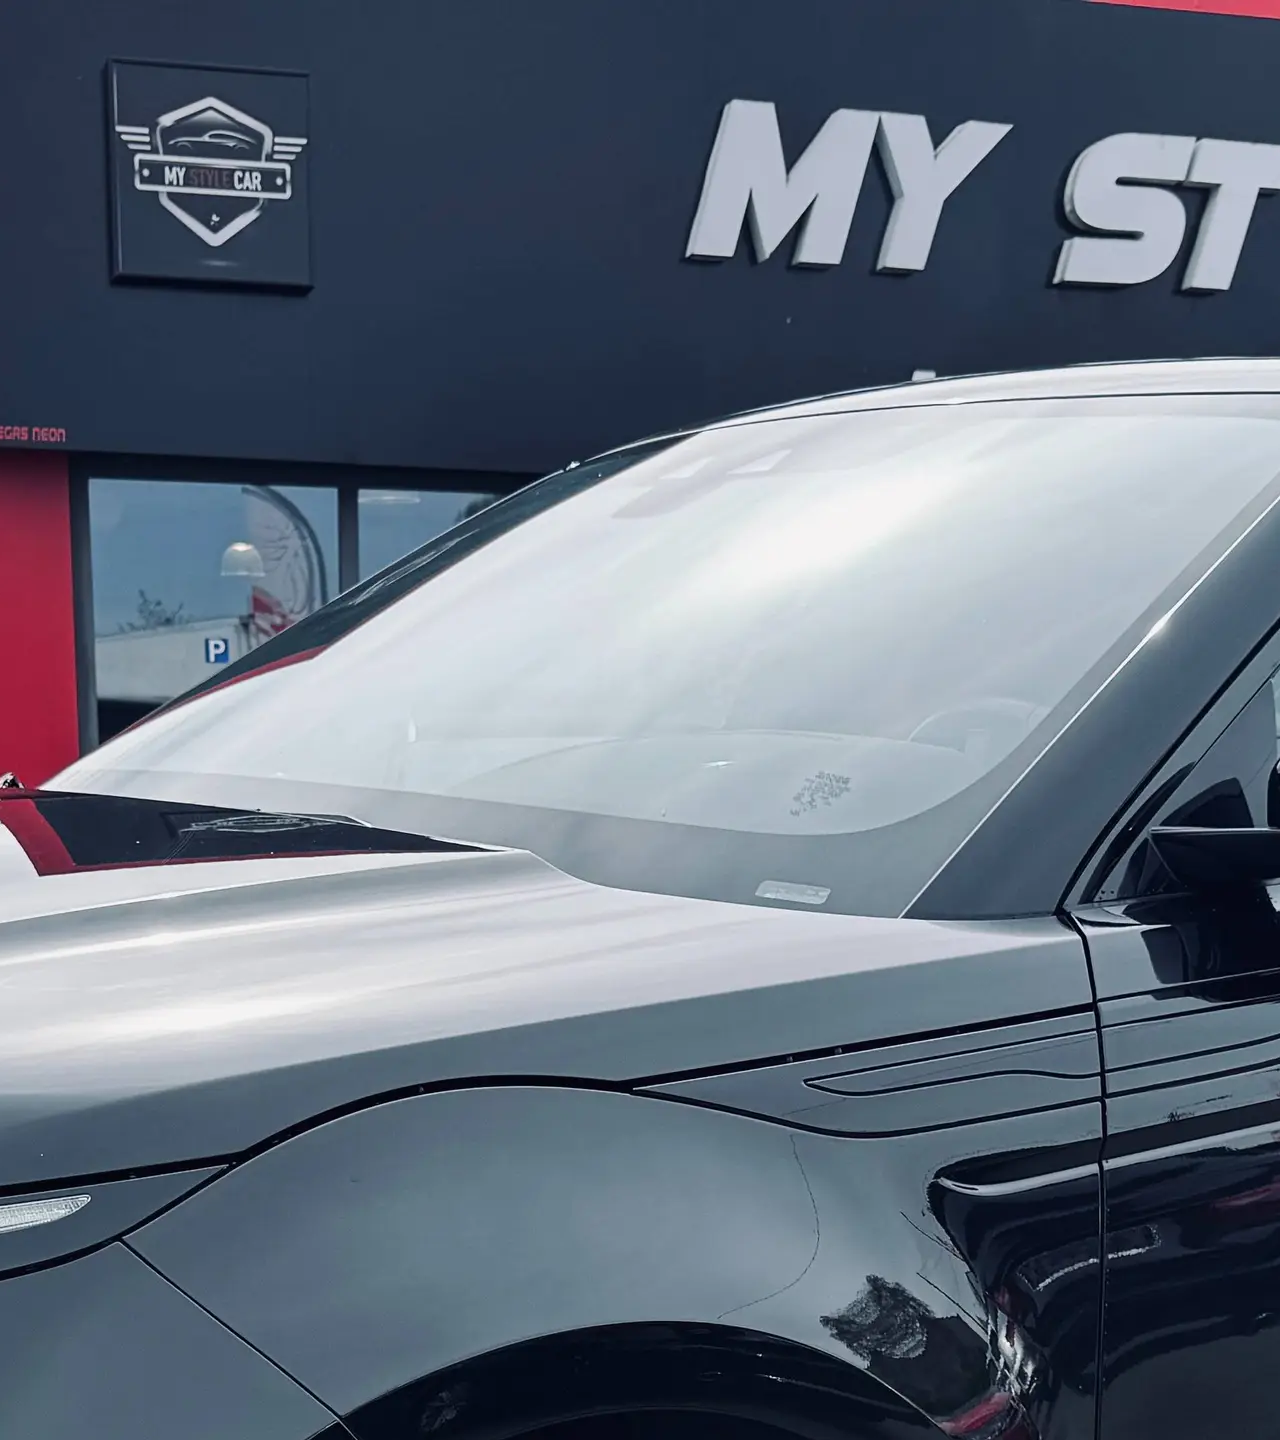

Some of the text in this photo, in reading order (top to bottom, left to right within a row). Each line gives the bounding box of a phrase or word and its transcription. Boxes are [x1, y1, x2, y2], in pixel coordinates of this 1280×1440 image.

[164, 165, 262, 191] MY STYLE CAR
[686, 98, 1014, 274] MY
[209, 639, 226, 662] P
